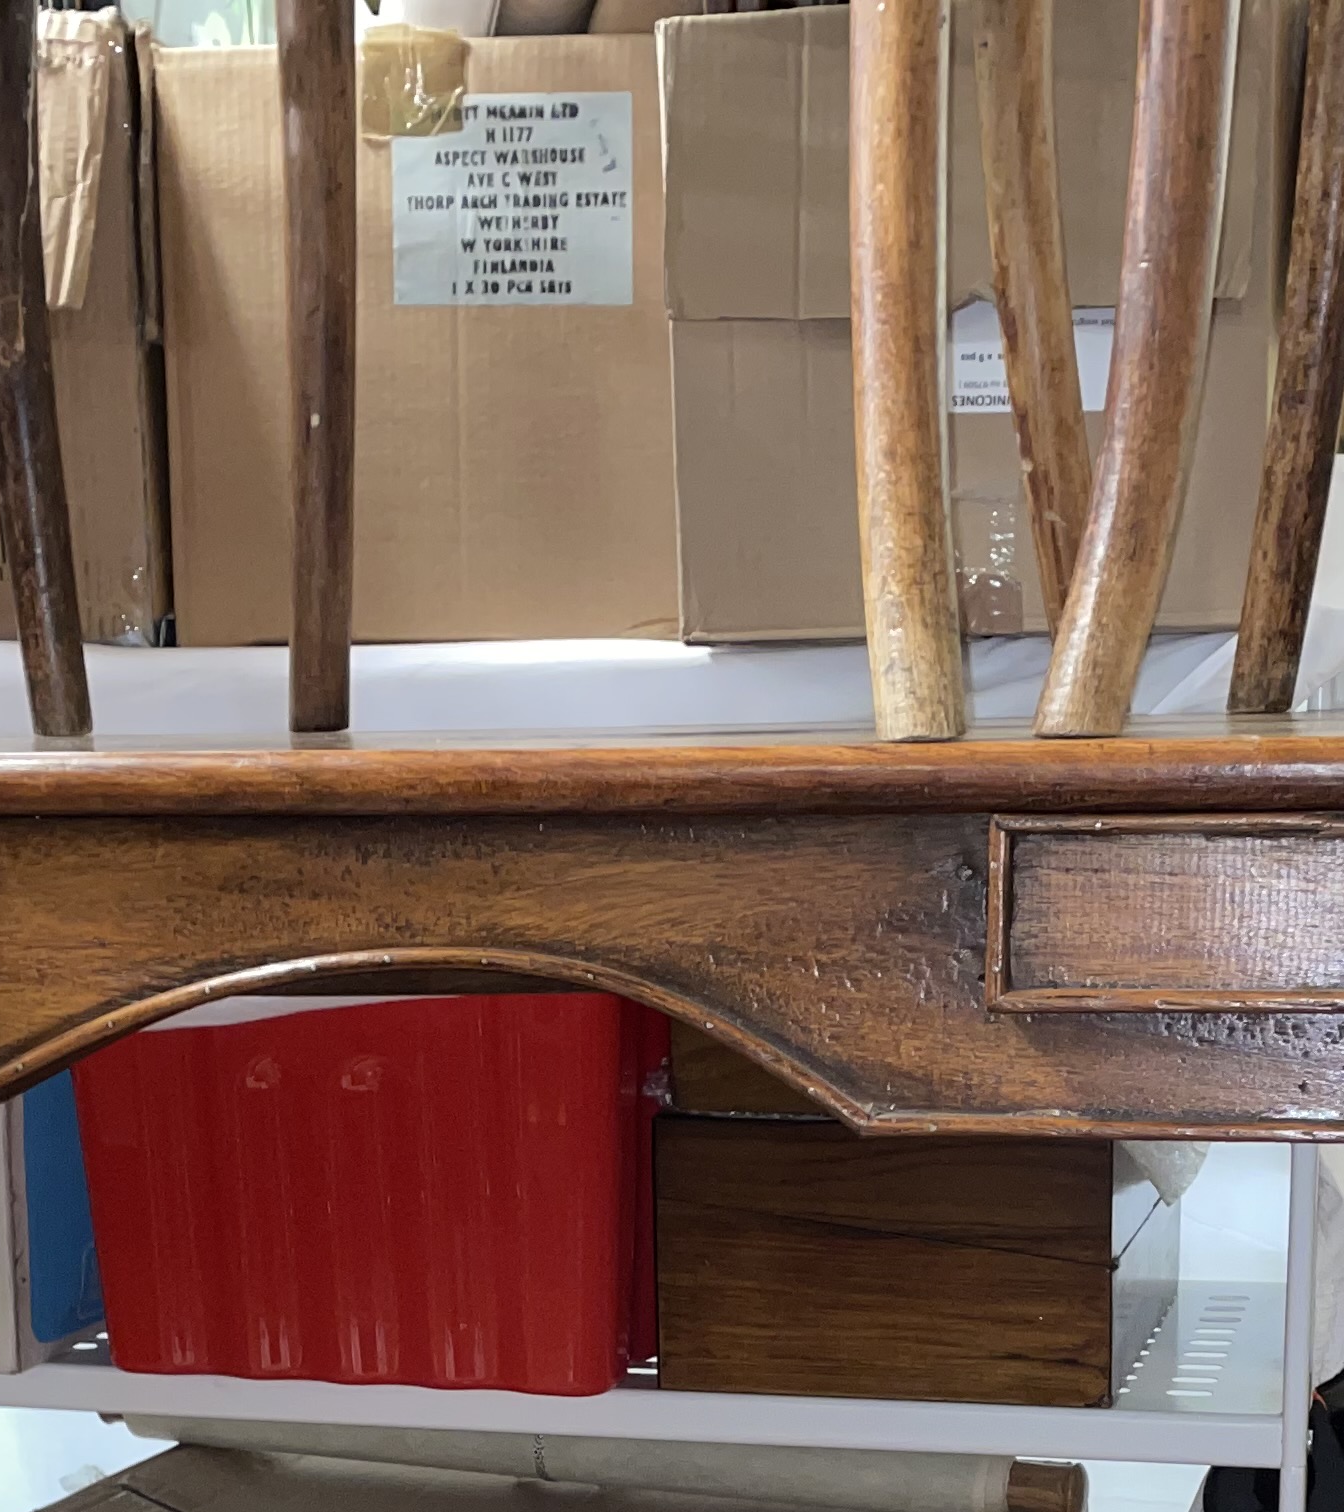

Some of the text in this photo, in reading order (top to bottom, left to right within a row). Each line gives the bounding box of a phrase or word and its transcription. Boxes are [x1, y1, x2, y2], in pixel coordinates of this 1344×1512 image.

[502, 127, 534, 142] 1177
[435, 150, 487, 167] ASPECT
[468, 172, 494, 188] AVE
[518, 171, 557, 187] WEST
[407, 195, 454, 211] THORP
[461, 194, 498, 210] ARCH
[576, 191, 627, 208] ESTATE
[461, 238, 476, 253] W
[952, 394, 1010, 407] NICONES
